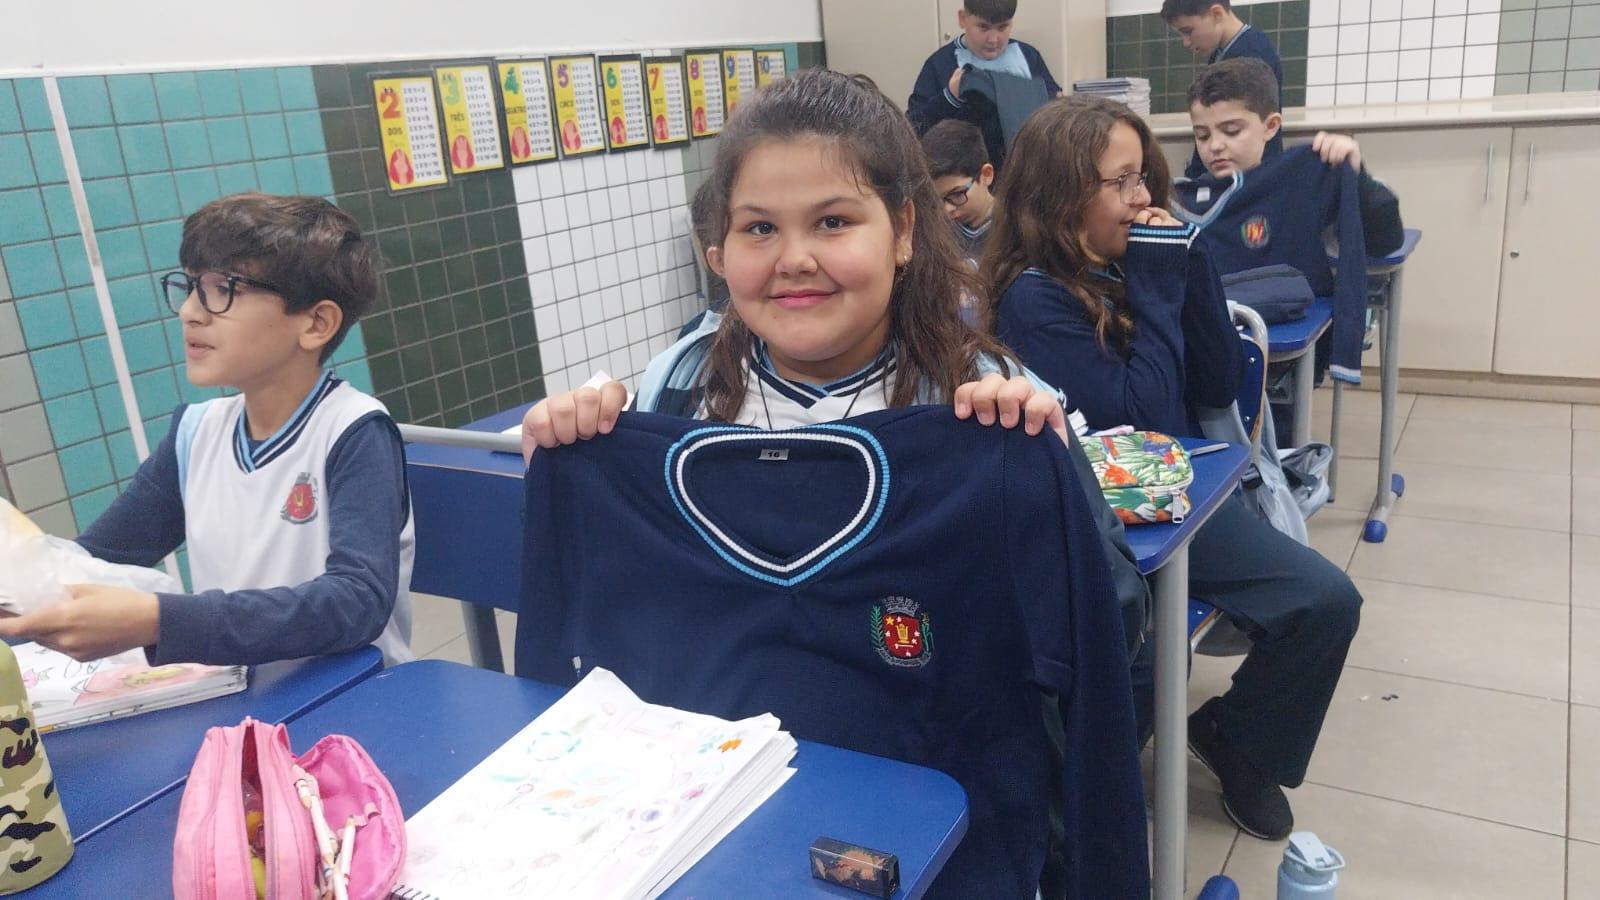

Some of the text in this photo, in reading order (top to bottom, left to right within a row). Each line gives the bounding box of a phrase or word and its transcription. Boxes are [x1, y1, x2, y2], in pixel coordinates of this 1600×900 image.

[557, 64, 568, 88] 5
[690, 58, 699, 80] 8
[726, 56, 735, 80] 9
[758, 56, 770, 74] 10
[442, 73, 460, 105] 3
[504, 66, 519, 94] 4
[607, 68, 616, 88] 6
[649, 68, 658, 90] 7
[379, 89, 400, 119] 2
[450, 112, 465, 121] TRÊS
[387, 127, 403, 136] DOIS
